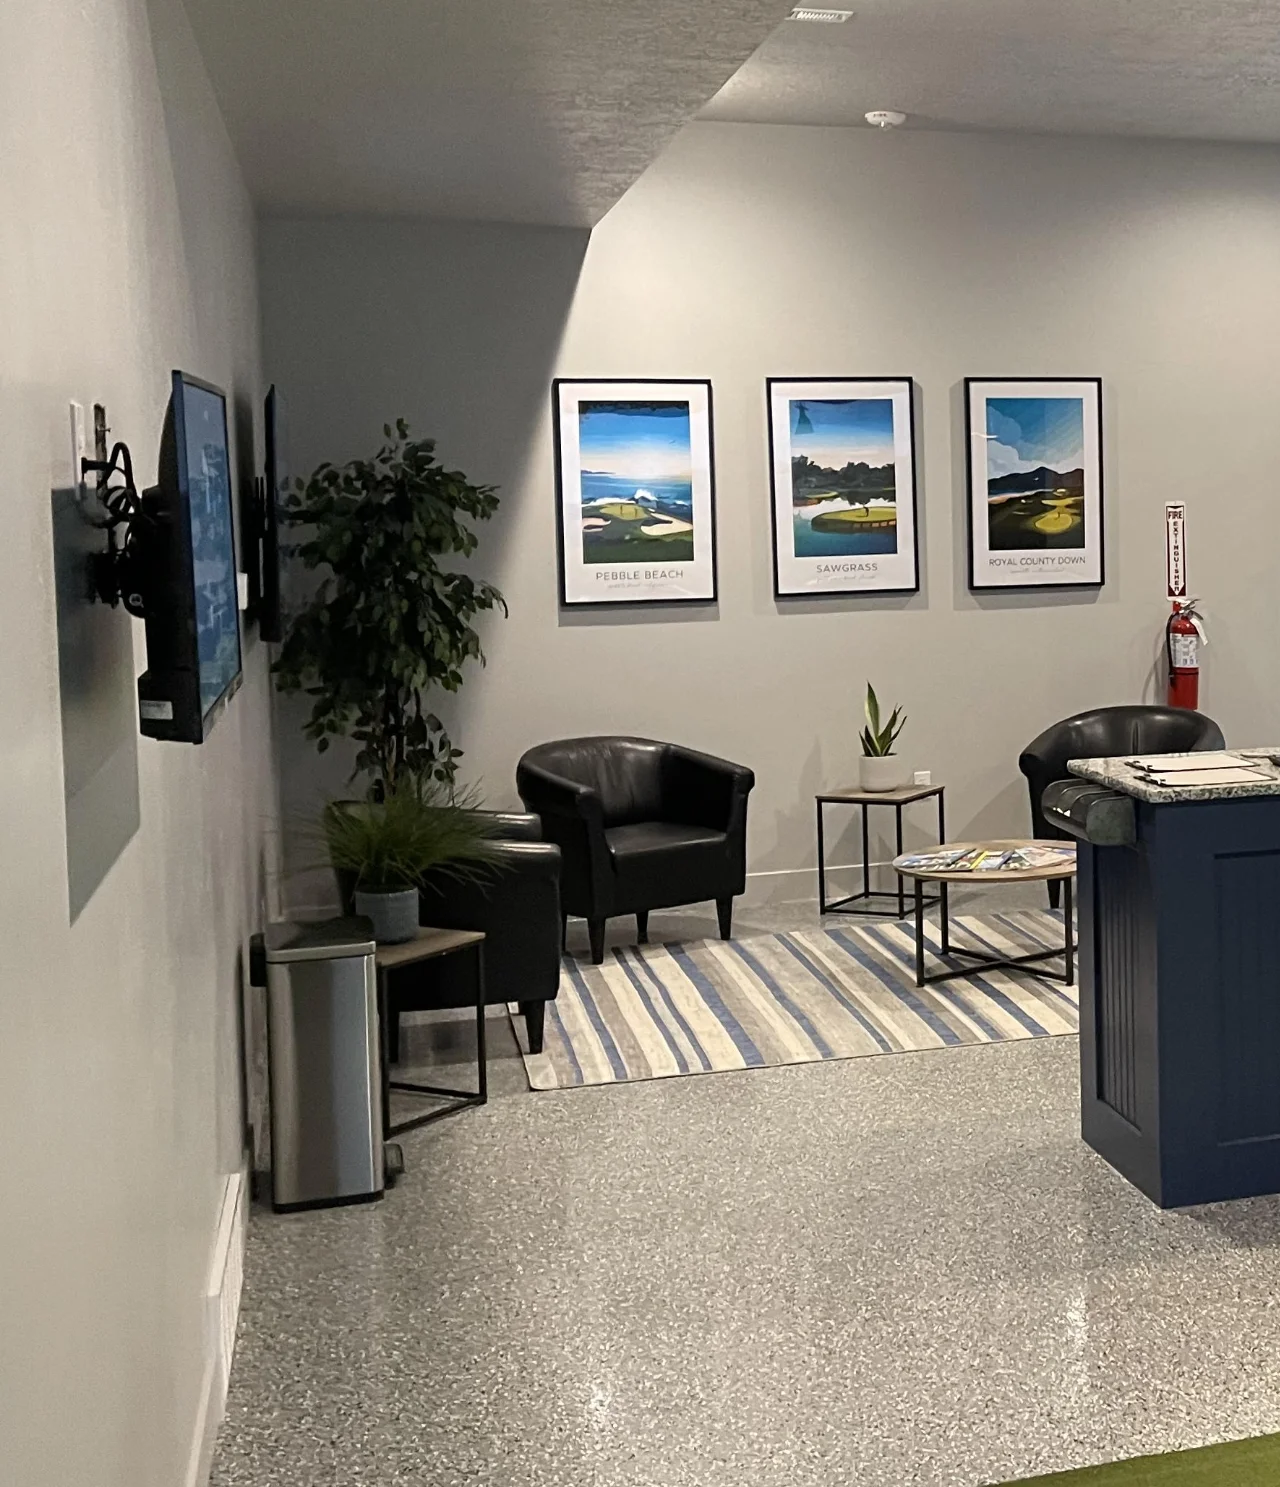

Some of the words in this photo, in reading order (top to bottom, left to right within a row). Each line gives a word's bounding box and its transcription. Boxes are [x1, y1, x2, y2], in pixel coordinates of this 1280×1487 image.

[1168, 510, 1183, 519] FIRE
[989, 558, 1018, 567] ROYAL
[1019, 556, 1056, 566] COUNTY
[1057, 556, 1086, 565] DOWN
[816, 562, 879, 574] SAWGRASS
[595, 571, 640, 581] PEBBLE
[644, 569, 684, 580] BEACH
